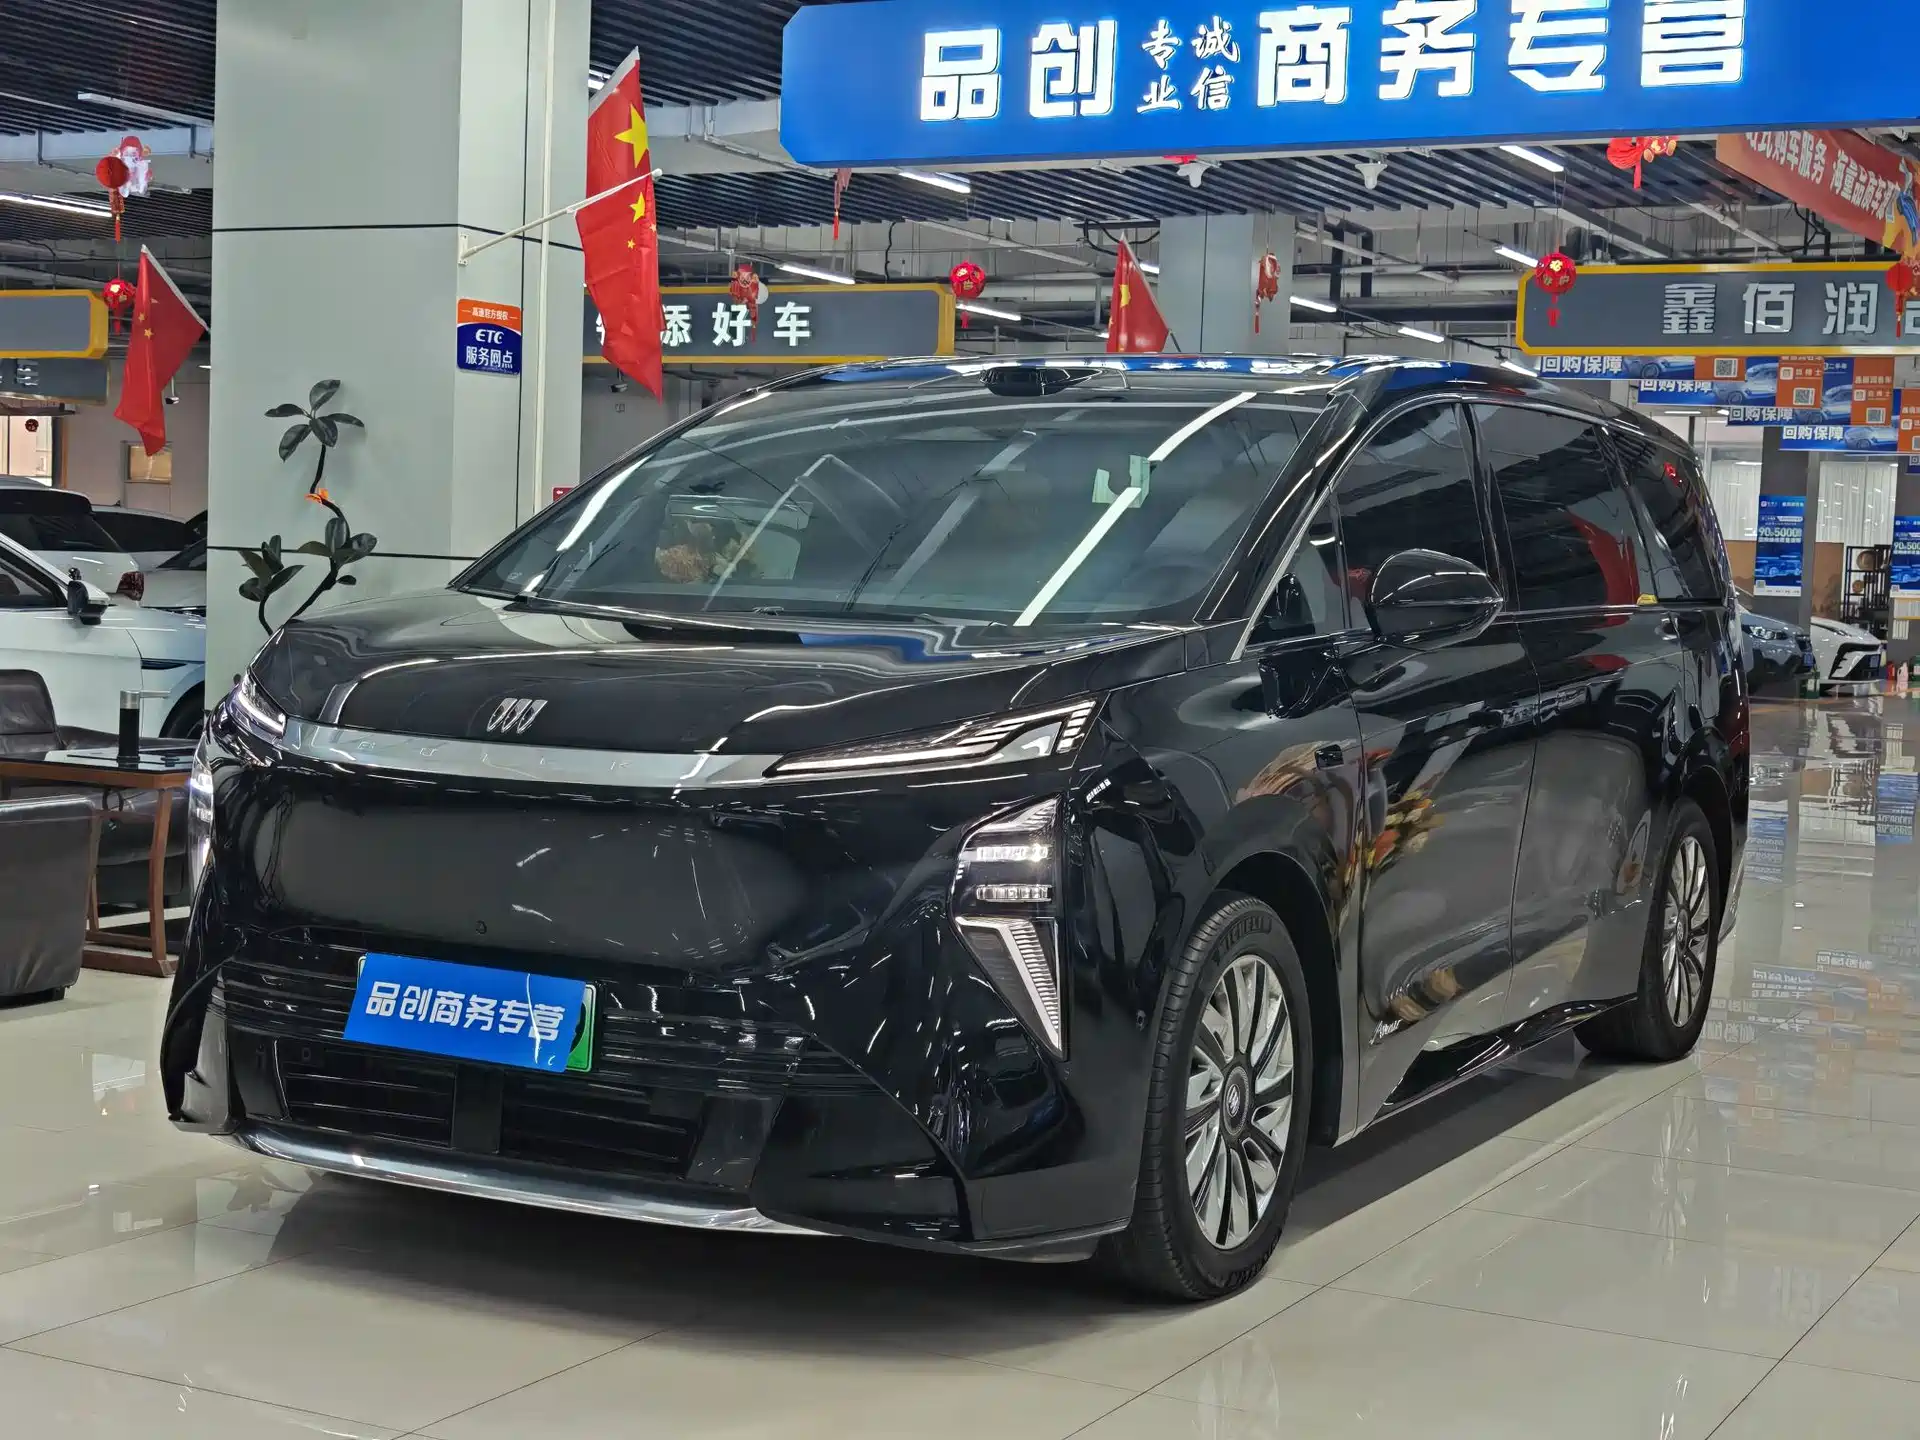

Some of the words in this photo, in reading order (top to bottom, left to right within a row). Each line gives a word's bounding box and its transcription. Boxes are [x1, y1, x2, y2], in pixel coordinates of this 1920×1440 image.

[920, 19, 1117, 121] 品创
[595, 302, 811, 347] 添好车
[475, 328, 505, 345] ETC
[465, 345, 513, 369] 服务网点
[1541, 356, 1623, 374] 回购保障
[1640, 380, 1713, 393] 回购保障
[1729, 405, 1793, 422] 回购保障
[1782, 425, 1844, 440] 回购保障
[365, 981, 566, 1042] 品创商务专营
